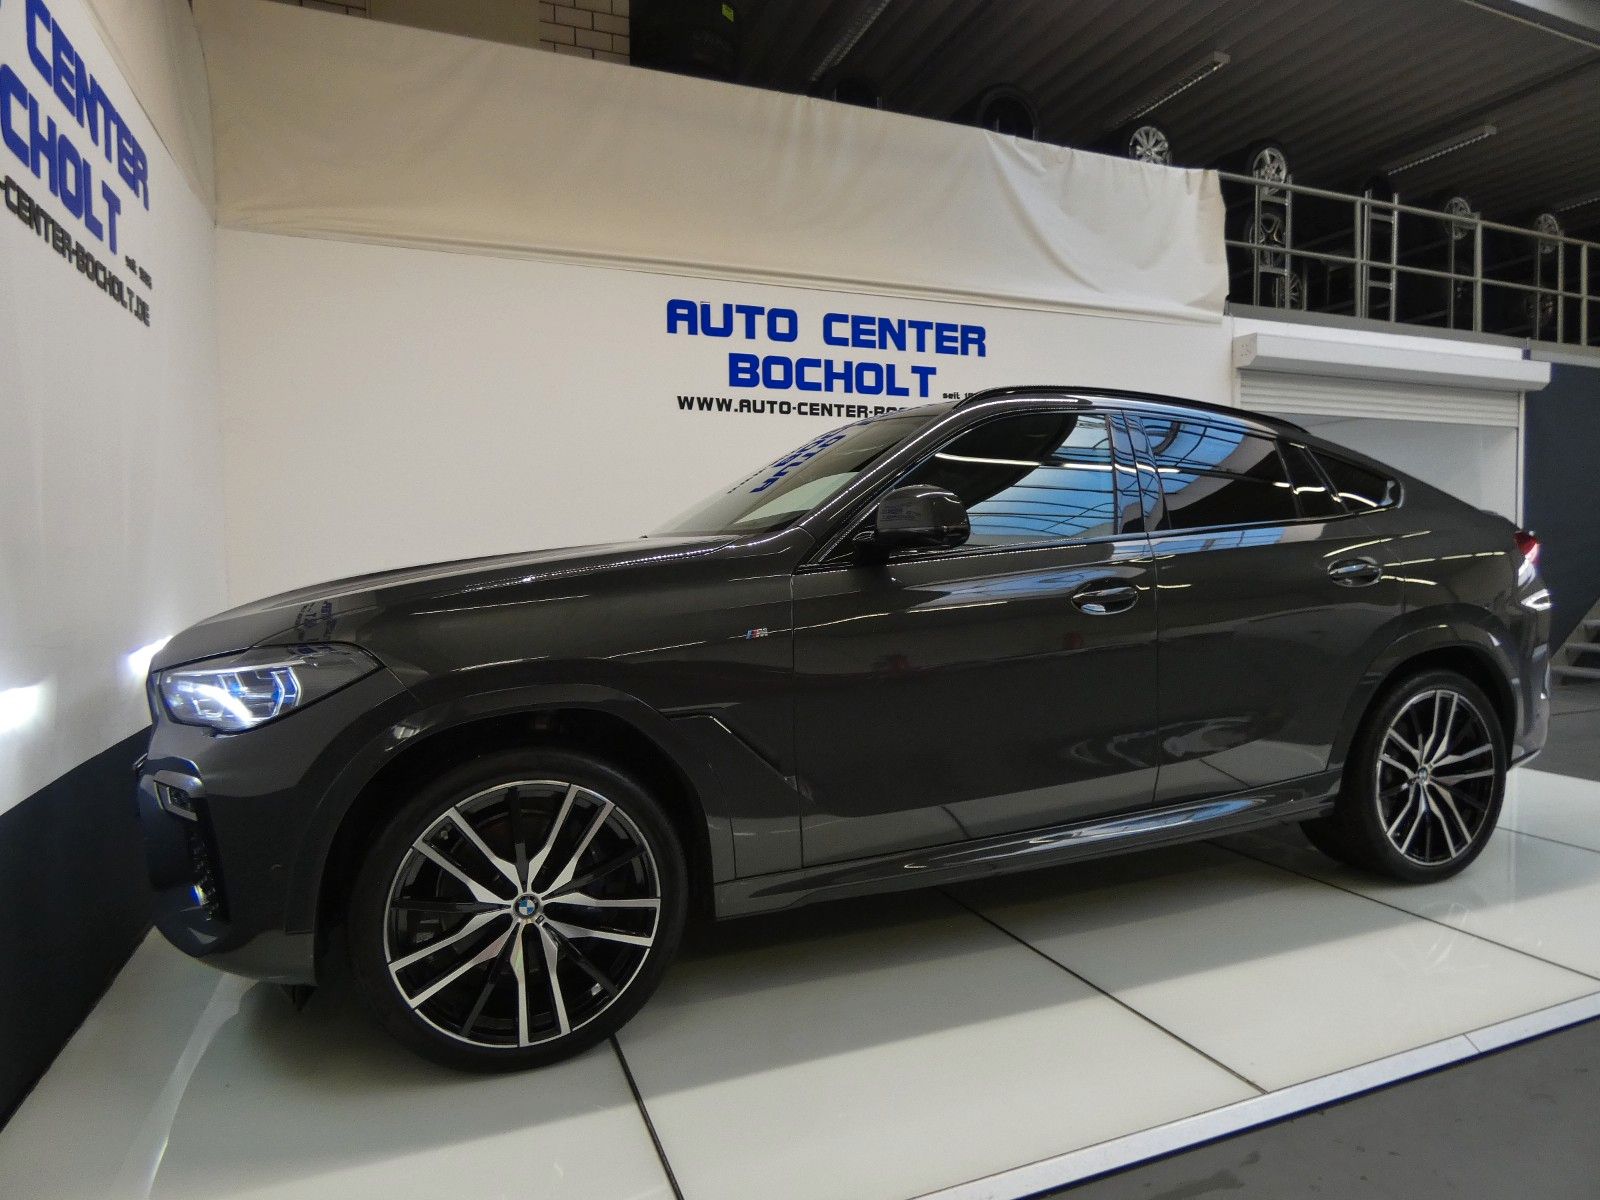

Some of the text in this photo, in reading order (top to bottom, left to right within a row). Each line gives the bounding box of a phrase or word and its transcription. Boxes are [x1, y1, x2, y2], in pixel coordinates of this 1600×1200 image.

[26, 0, 150, 211] CENTER
[667, 298, 986, 357] AUTO CENTER
[728, 352, 937, 398] BOCHOLT
